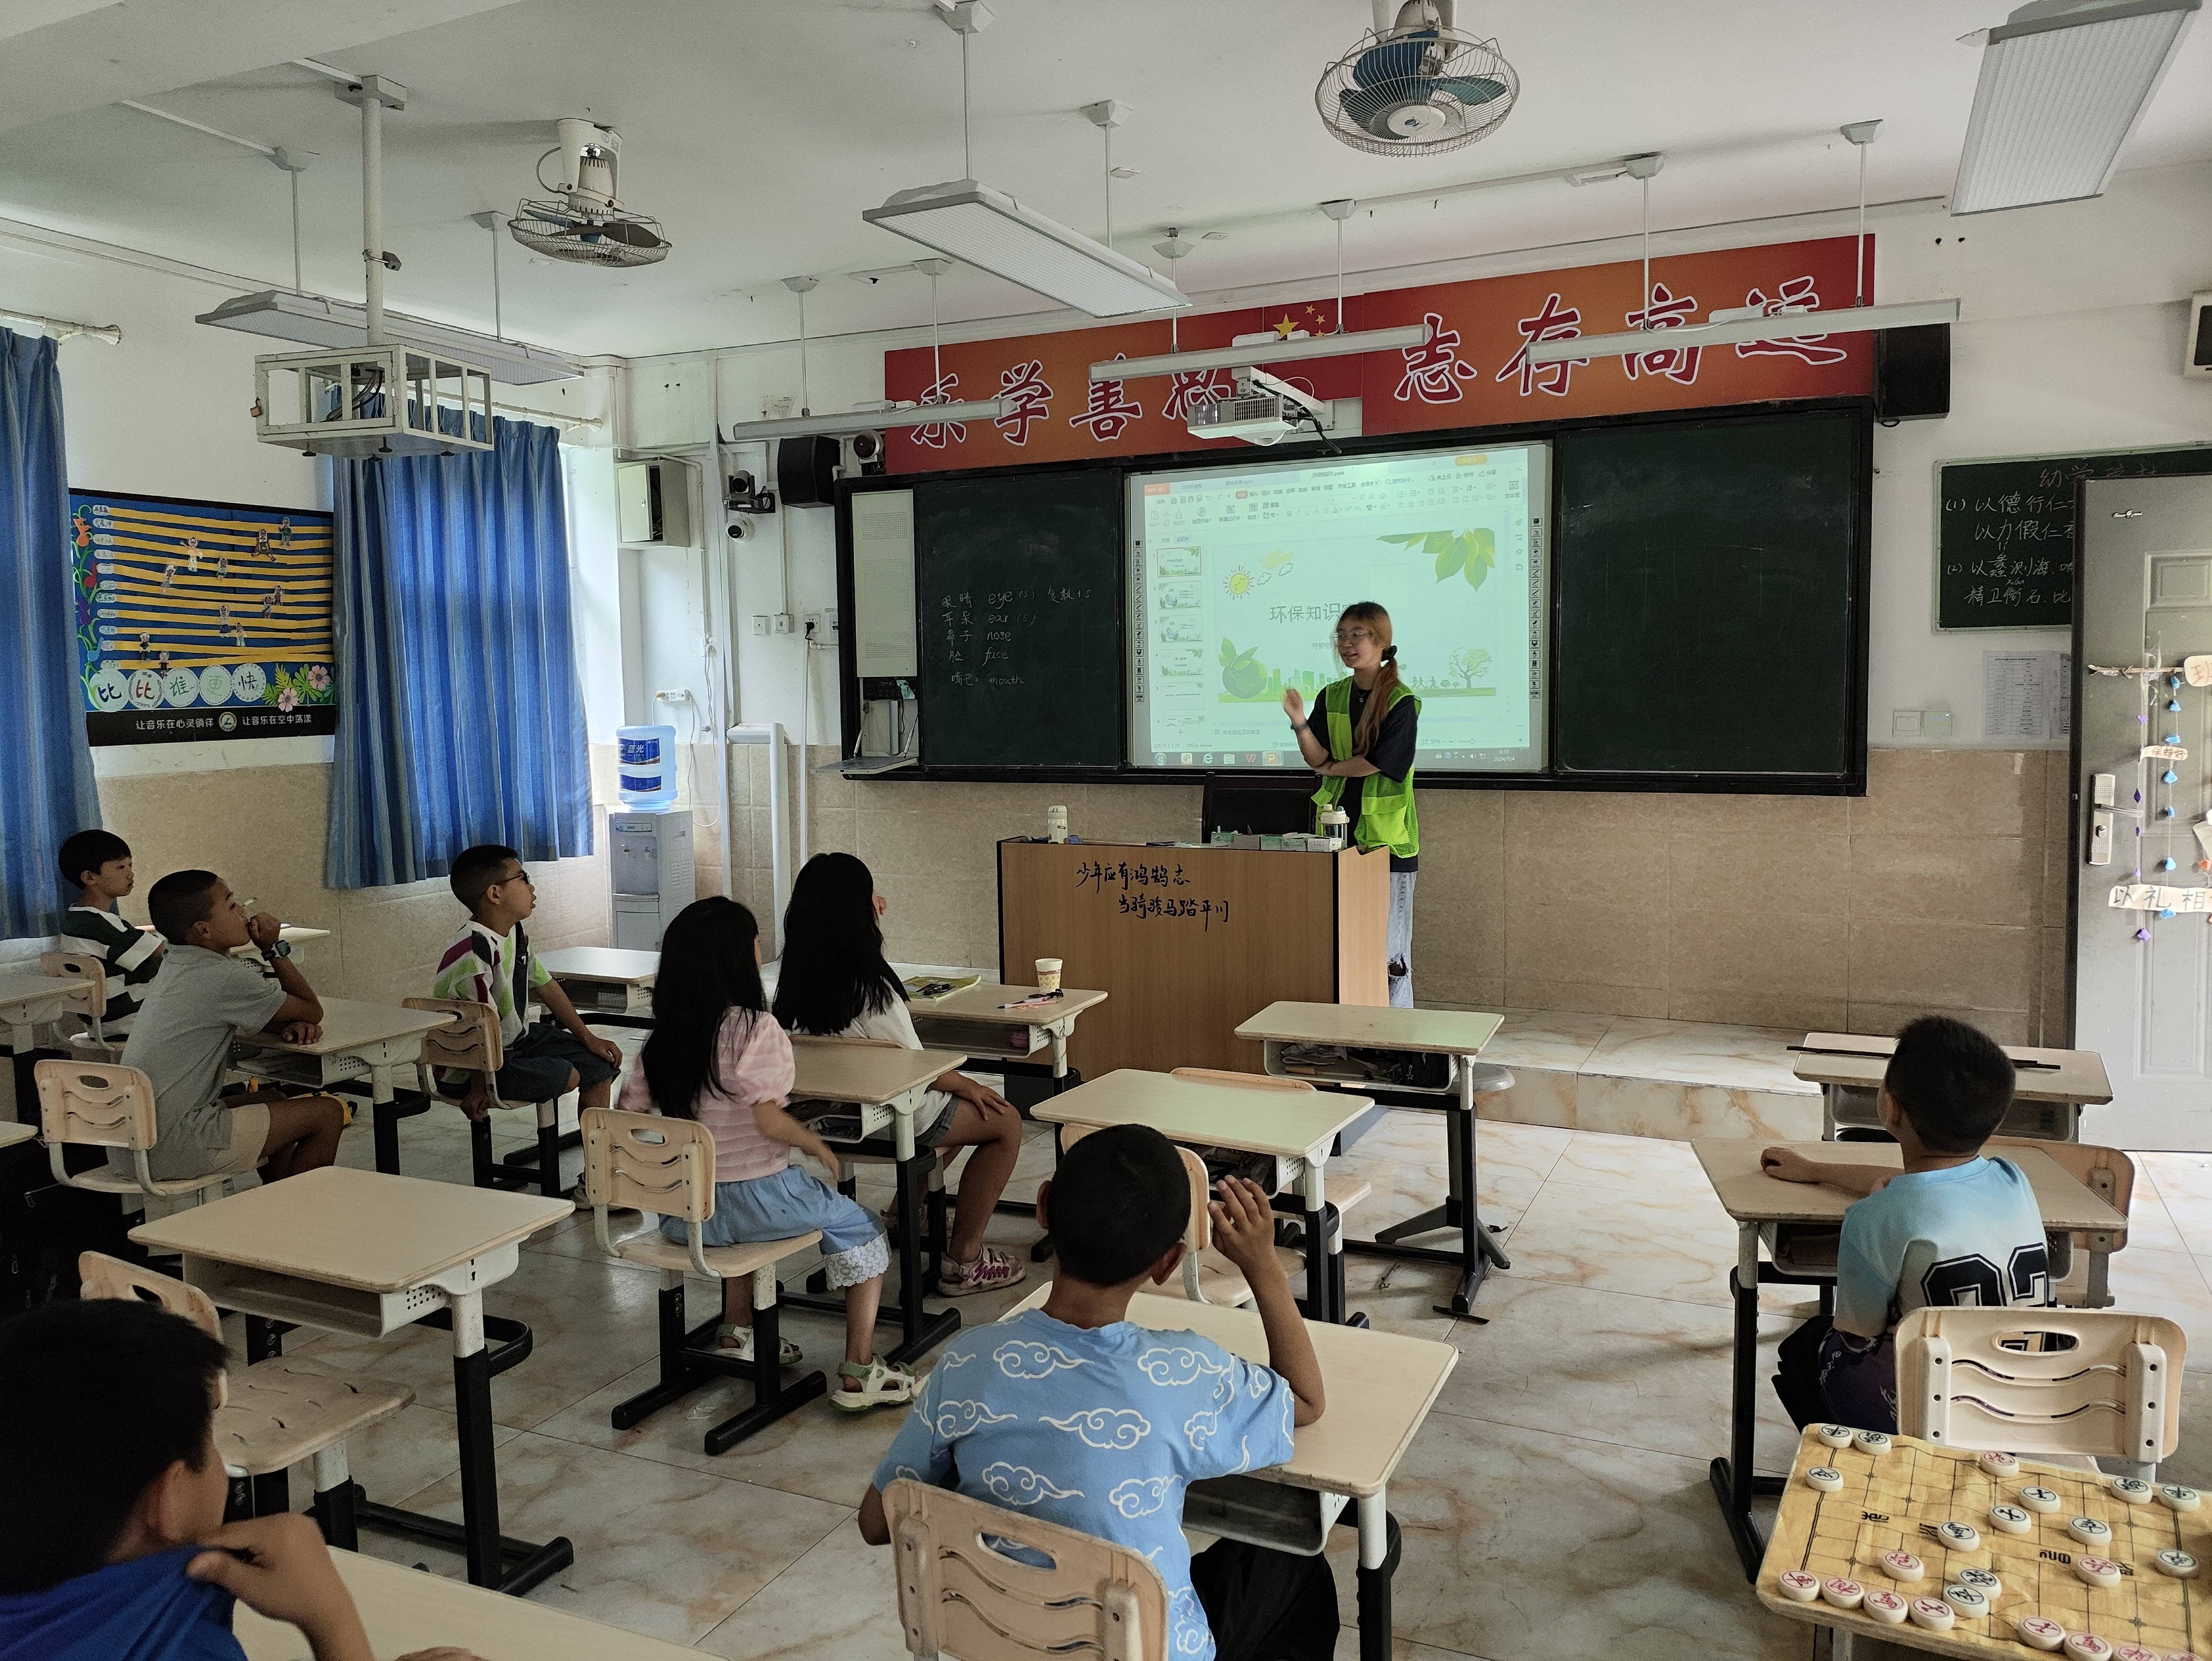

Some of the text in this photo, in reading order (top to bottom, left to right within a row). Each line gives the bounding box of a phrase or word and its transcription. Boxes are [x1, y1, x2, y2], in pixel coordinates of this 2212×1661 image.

[1975, 491, 2074, 514] 以德行仁
[988, 590, 1014, 609] eye
[988, 614, 1010, 624] ear
[1270, 603, 1351, 623] 环保知识
[986, 631, 1012, 642] nose
[982, 647, 1009, 667] face
[988, 674, 1024, 685] mouth
[136, 714, 312, 730] 让音乐在心灵徜徉 让音乐在空中荡漾
[627, 744, 645, 753] 蓝光
[1075, 861, 1191, 894] 少年应有鸿鹄志
[2114, 886, 2212, 911] 以礼相
[1118, 893, 1229, 932] 当骑骏马踏平川
